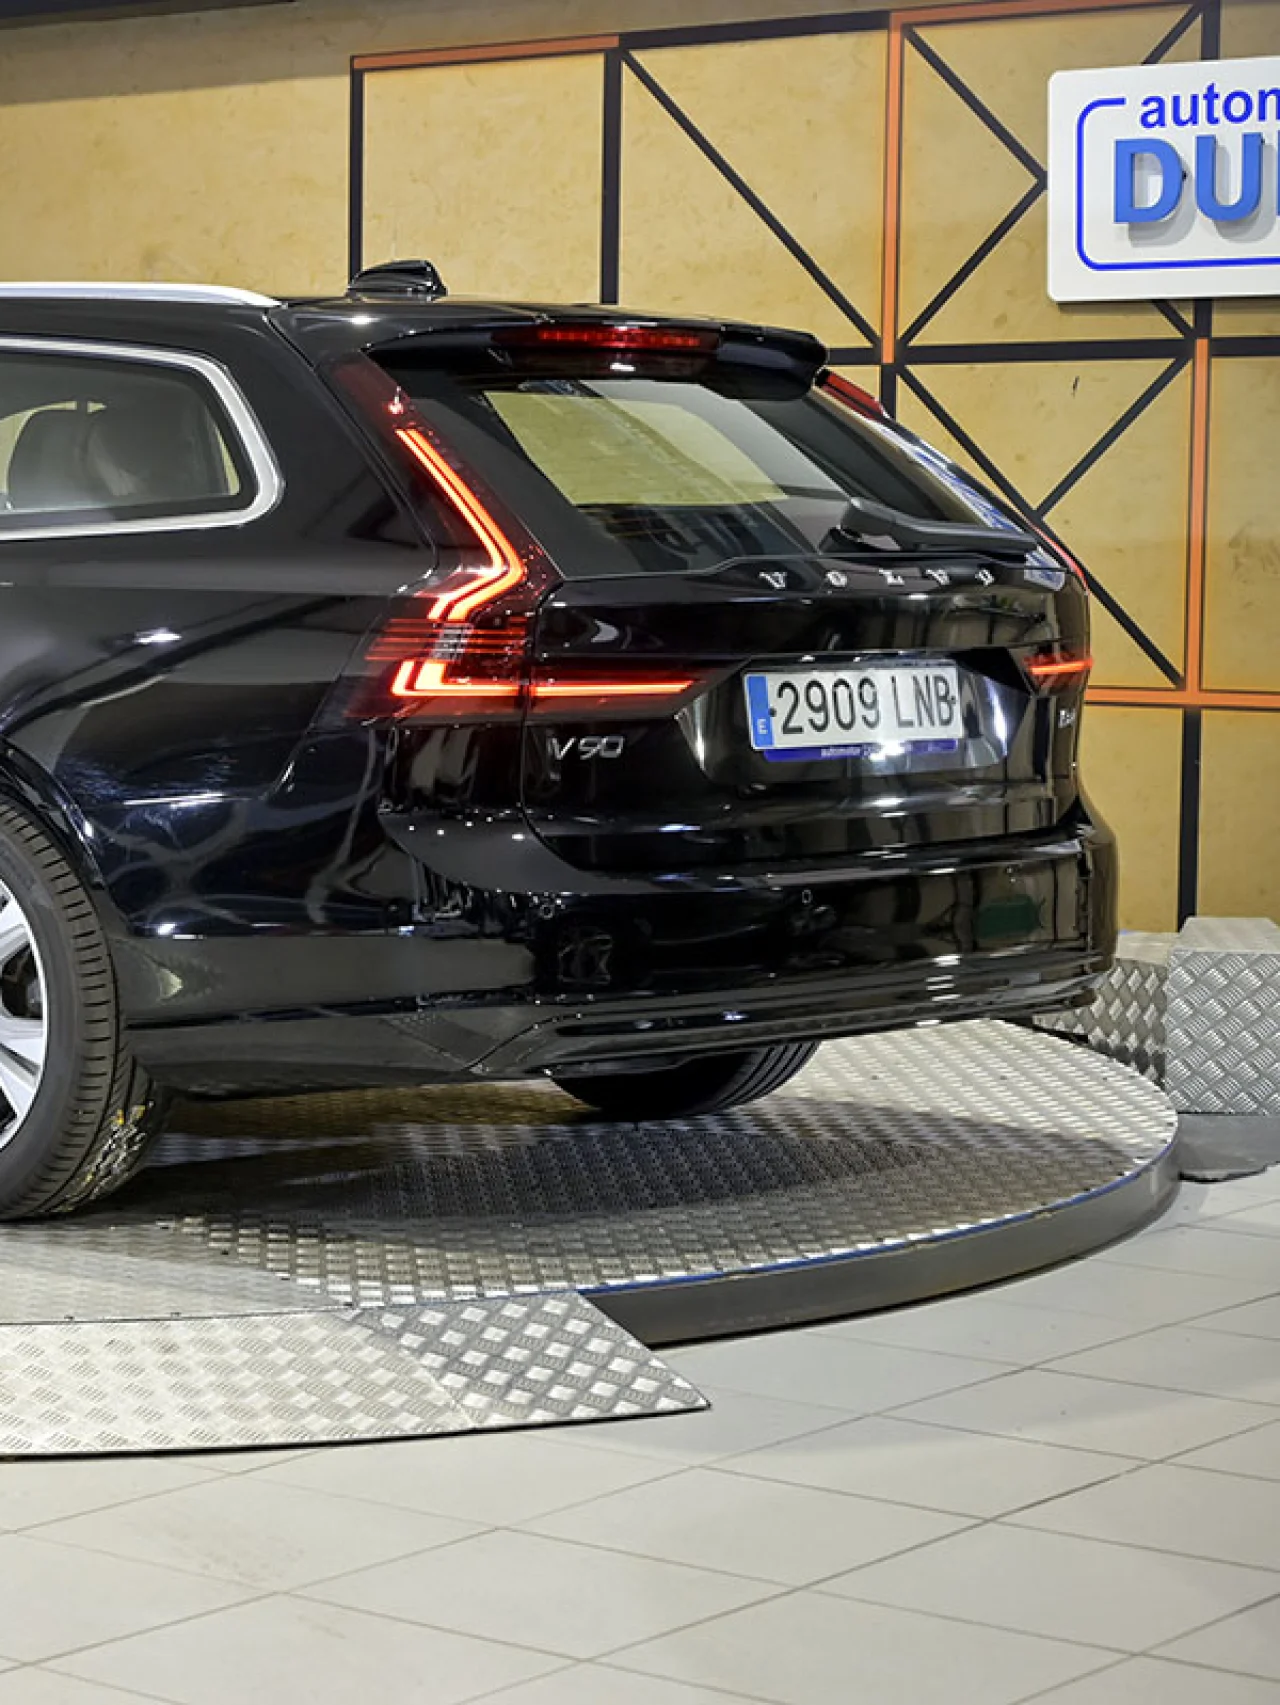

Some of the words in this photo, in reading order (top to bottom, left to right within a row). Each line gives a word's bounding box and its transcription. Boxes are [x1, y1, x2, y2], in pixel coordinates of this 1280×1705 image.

[1114, 131, 1280, 223] DU
[760, 568, 995, 590] VOLVO
[756, 718, 768, 735] E
[776, 677, 881, 735] 2909
[891, 674, 953, 728] LNB
[549, 736, 624, 760] V90
